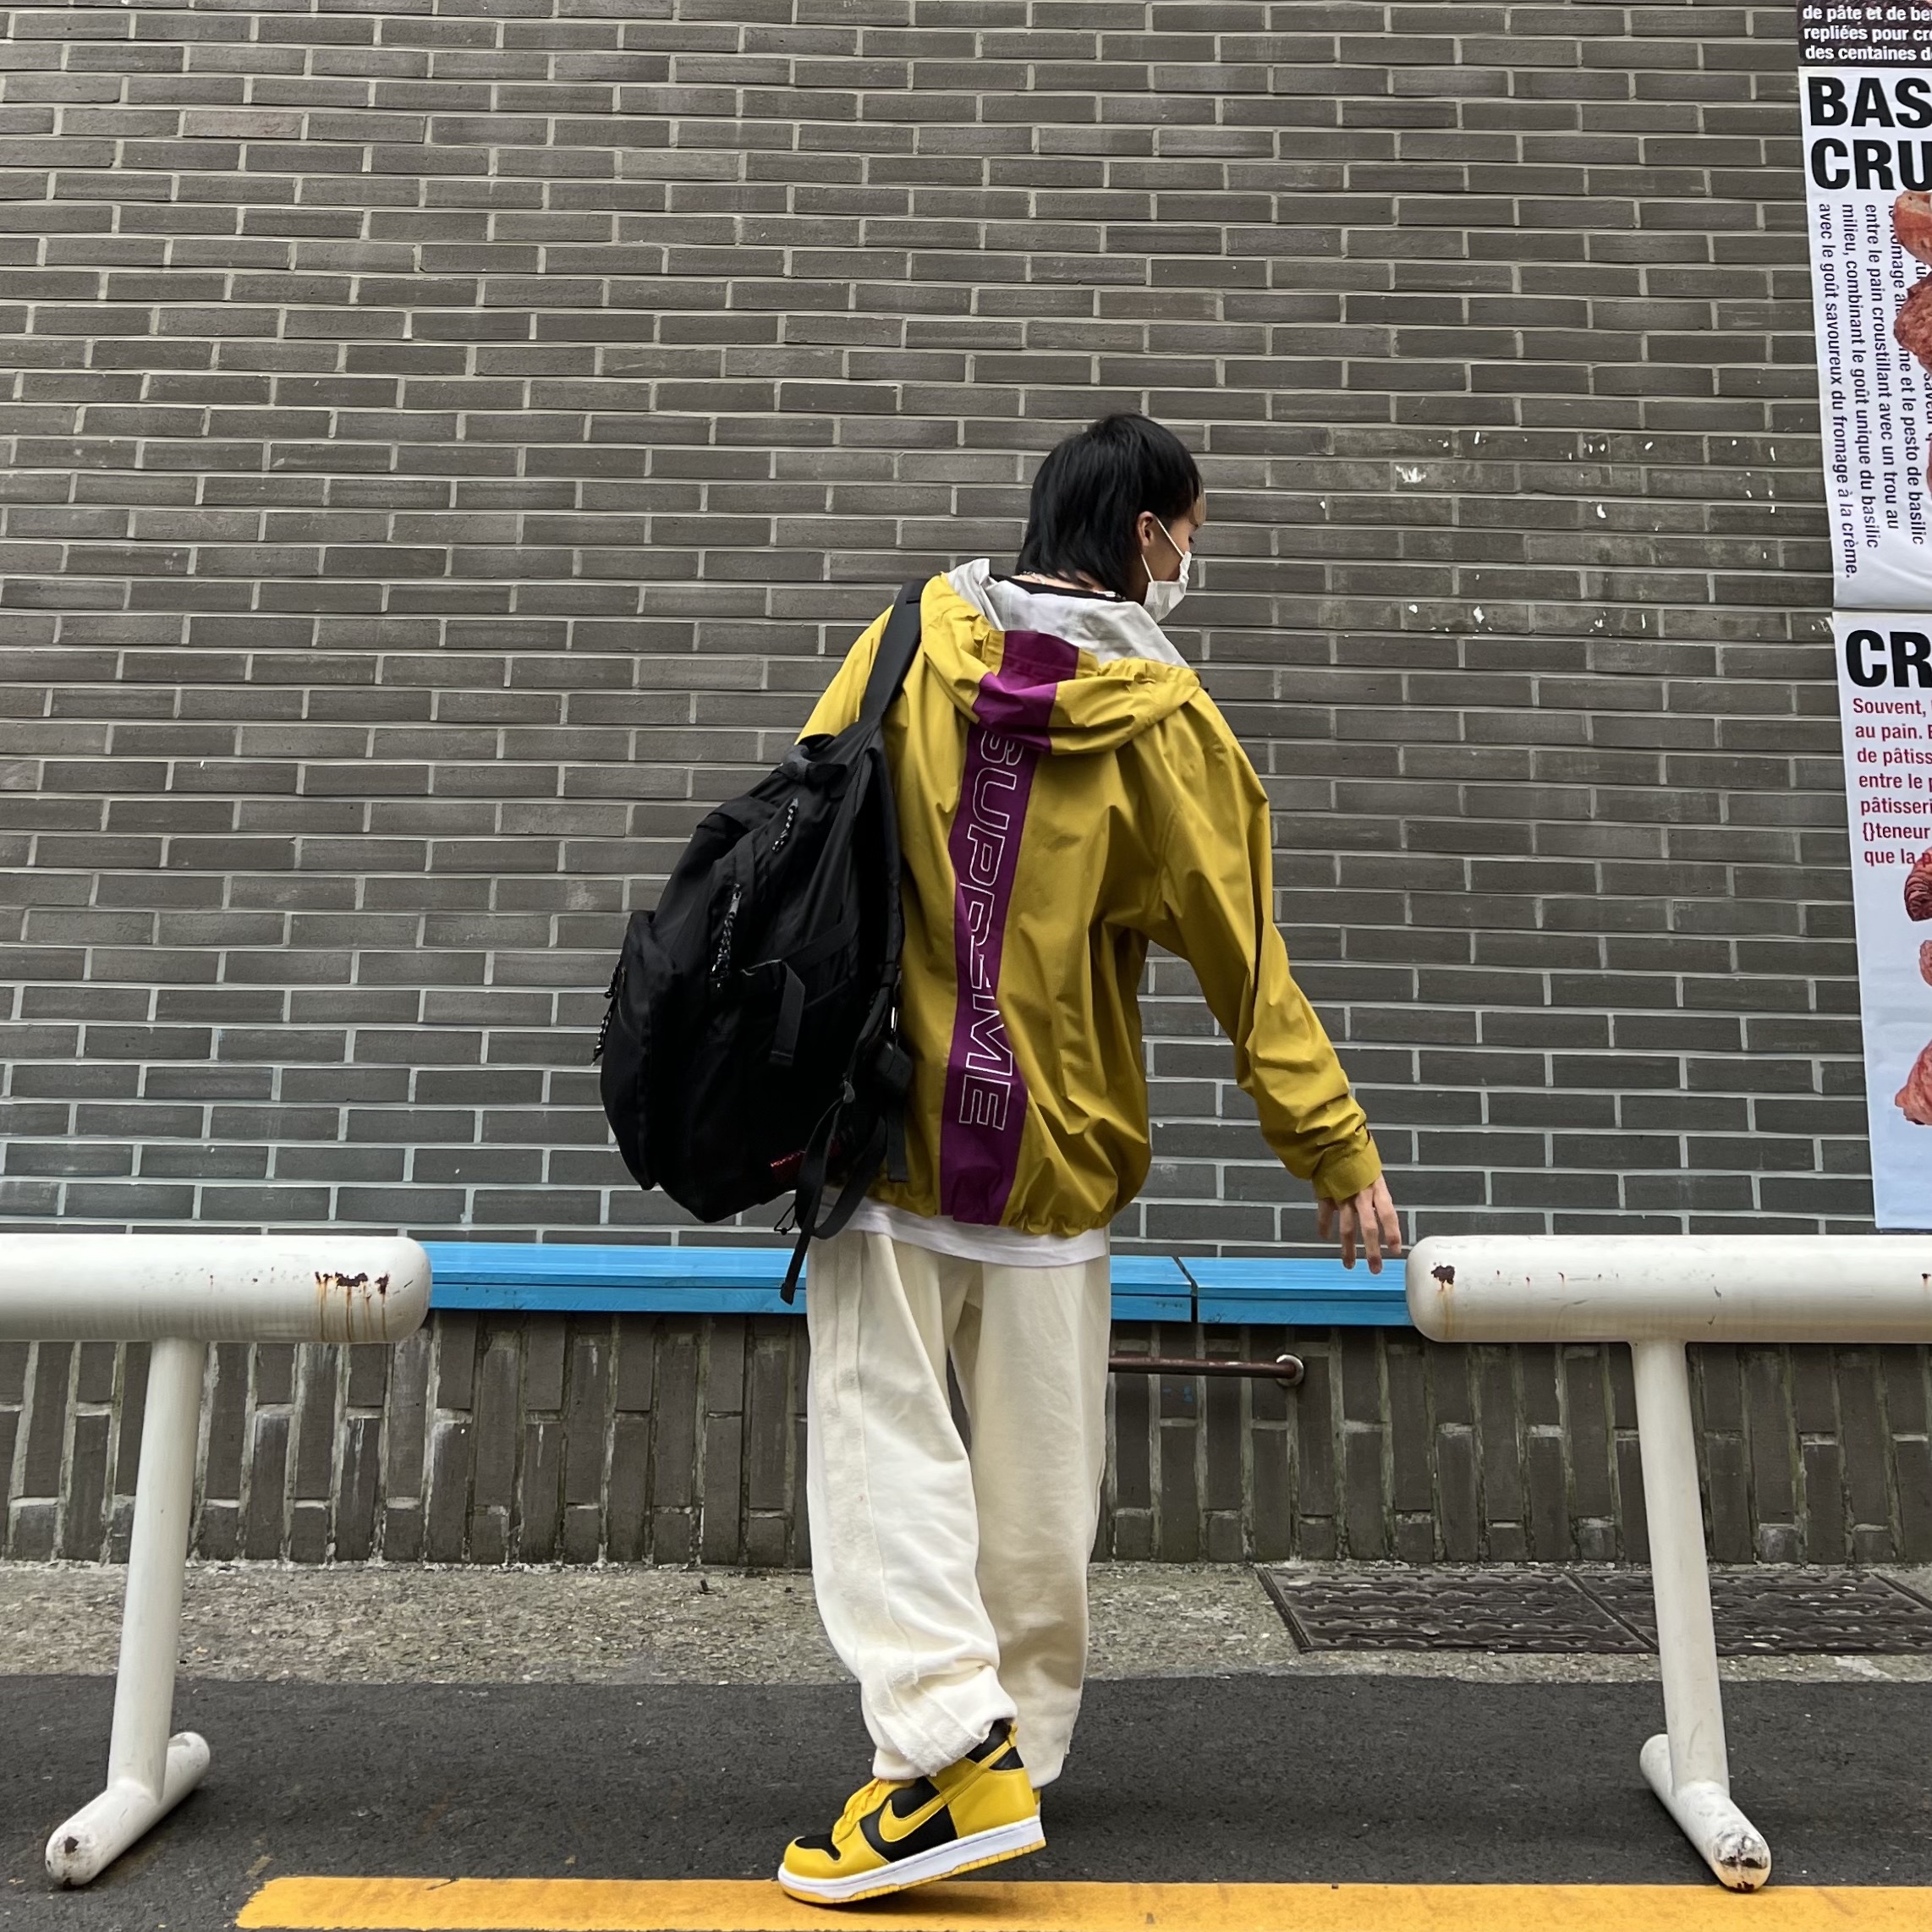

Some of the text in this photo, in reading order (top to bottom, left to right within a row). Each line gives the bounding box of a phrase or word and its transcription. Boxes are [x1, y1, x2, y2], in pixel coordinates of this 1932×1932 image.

[1803, 5, 1932, 22] de pâte et de be
[1803, 25, 1868, 42] repliées
[1872, 29, 1909, 43] pour
[1805, 45, 1932, 61] des centaines d
[1808, 76, 1932, 129] BAS
[1810, 137, 1932, 191] CRU
[1841, 204, 1881, 548] milieu, combinant le goût unique du basilic
[1865, 204, 1899, 530] entre le pain croustillant avec un trou au
[1819, 203, 1859, 579] avec le goût savoureux du fromage à la crème.
[1901, 376, 1915, 392] et
[1902, 398, 1917, 411] le
[1900, 417, 1920, 461] pesto
[1907, 466, 1922, 486] de
[1908, 491, 1927, 546] basilic
[1846, 629, 1932, 688] CR
[1852, 698, 1926, 717] Souvent,
[1855, 725, 1875, 738] au
[1881, 723, 1923, 742] pain.
[1857, 747, 1877, 763] de
[1858, 773, 1902, 789] entre
[1907, 773, 1923, 789] le
[1864, 850, 1895, 867] que
[1901, 848, 1916, 864] la
